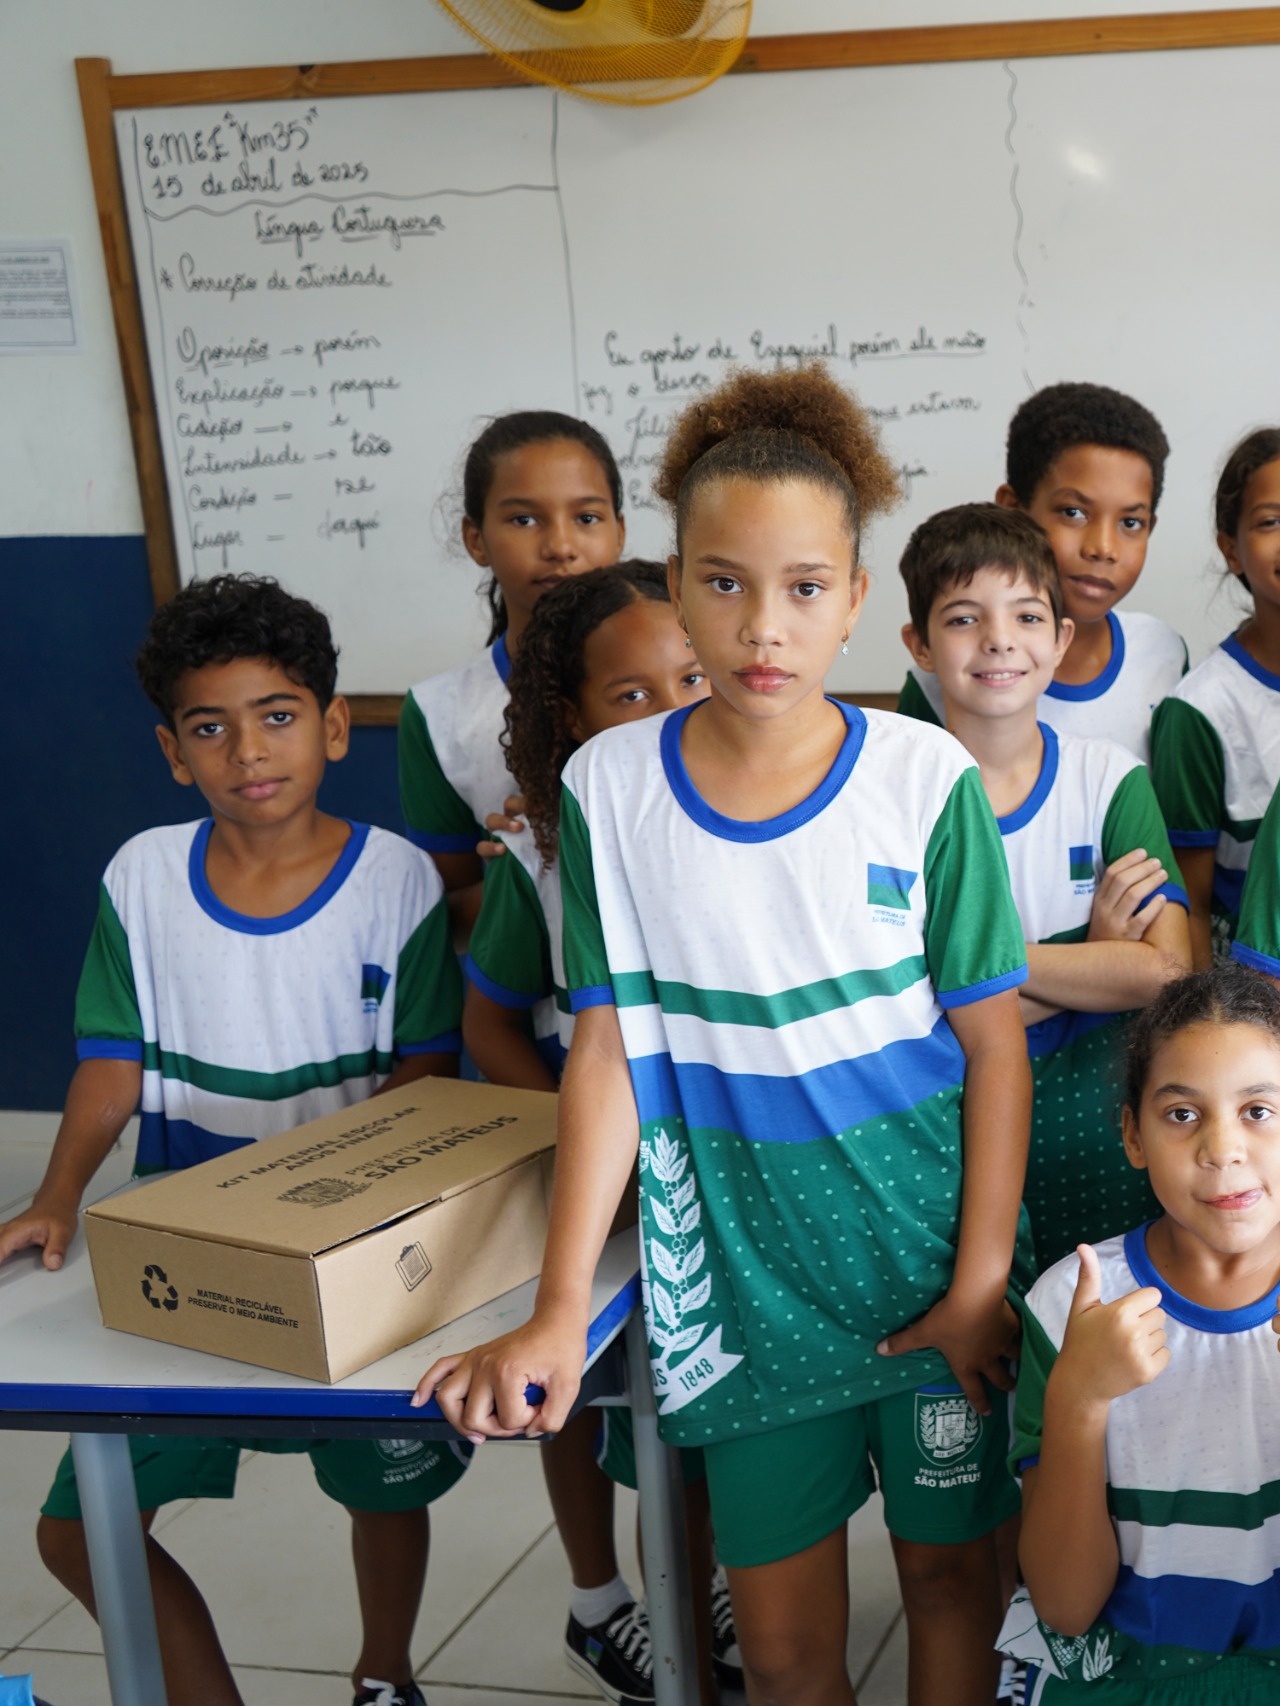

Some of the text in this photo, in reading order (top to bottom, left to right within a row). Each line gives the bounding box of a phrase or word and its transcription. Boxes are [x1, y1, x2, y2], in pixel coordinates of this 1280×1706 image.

[152, 157, 368, 198] 15 de abril de 2025
[266, 269, 291, 289] de
[296, 264, 392, 288] atividade
[708, 338, 738, 359] de
[216, 1106, 422, 1189] KIT MATERIAL ESCOLAR
[285, 1125, 393, 1171] ANOS FINAIS
[345, 1124, 466, 1175] PREFEITURA DE
[364, 1114, 519, 1180] SÃO MATEUS
[188, 1297, 299, 1328] PRESERVE O MEIO AMBIENTE
[197, 1289, 284, 1315] MATERIAL RECICLÁVEL
[679, 1357, 714, 1391] 1848
[914, 1475, 937, 1488] SÃO
[918, 1463, 979, 1478] PREFEITURA DE
